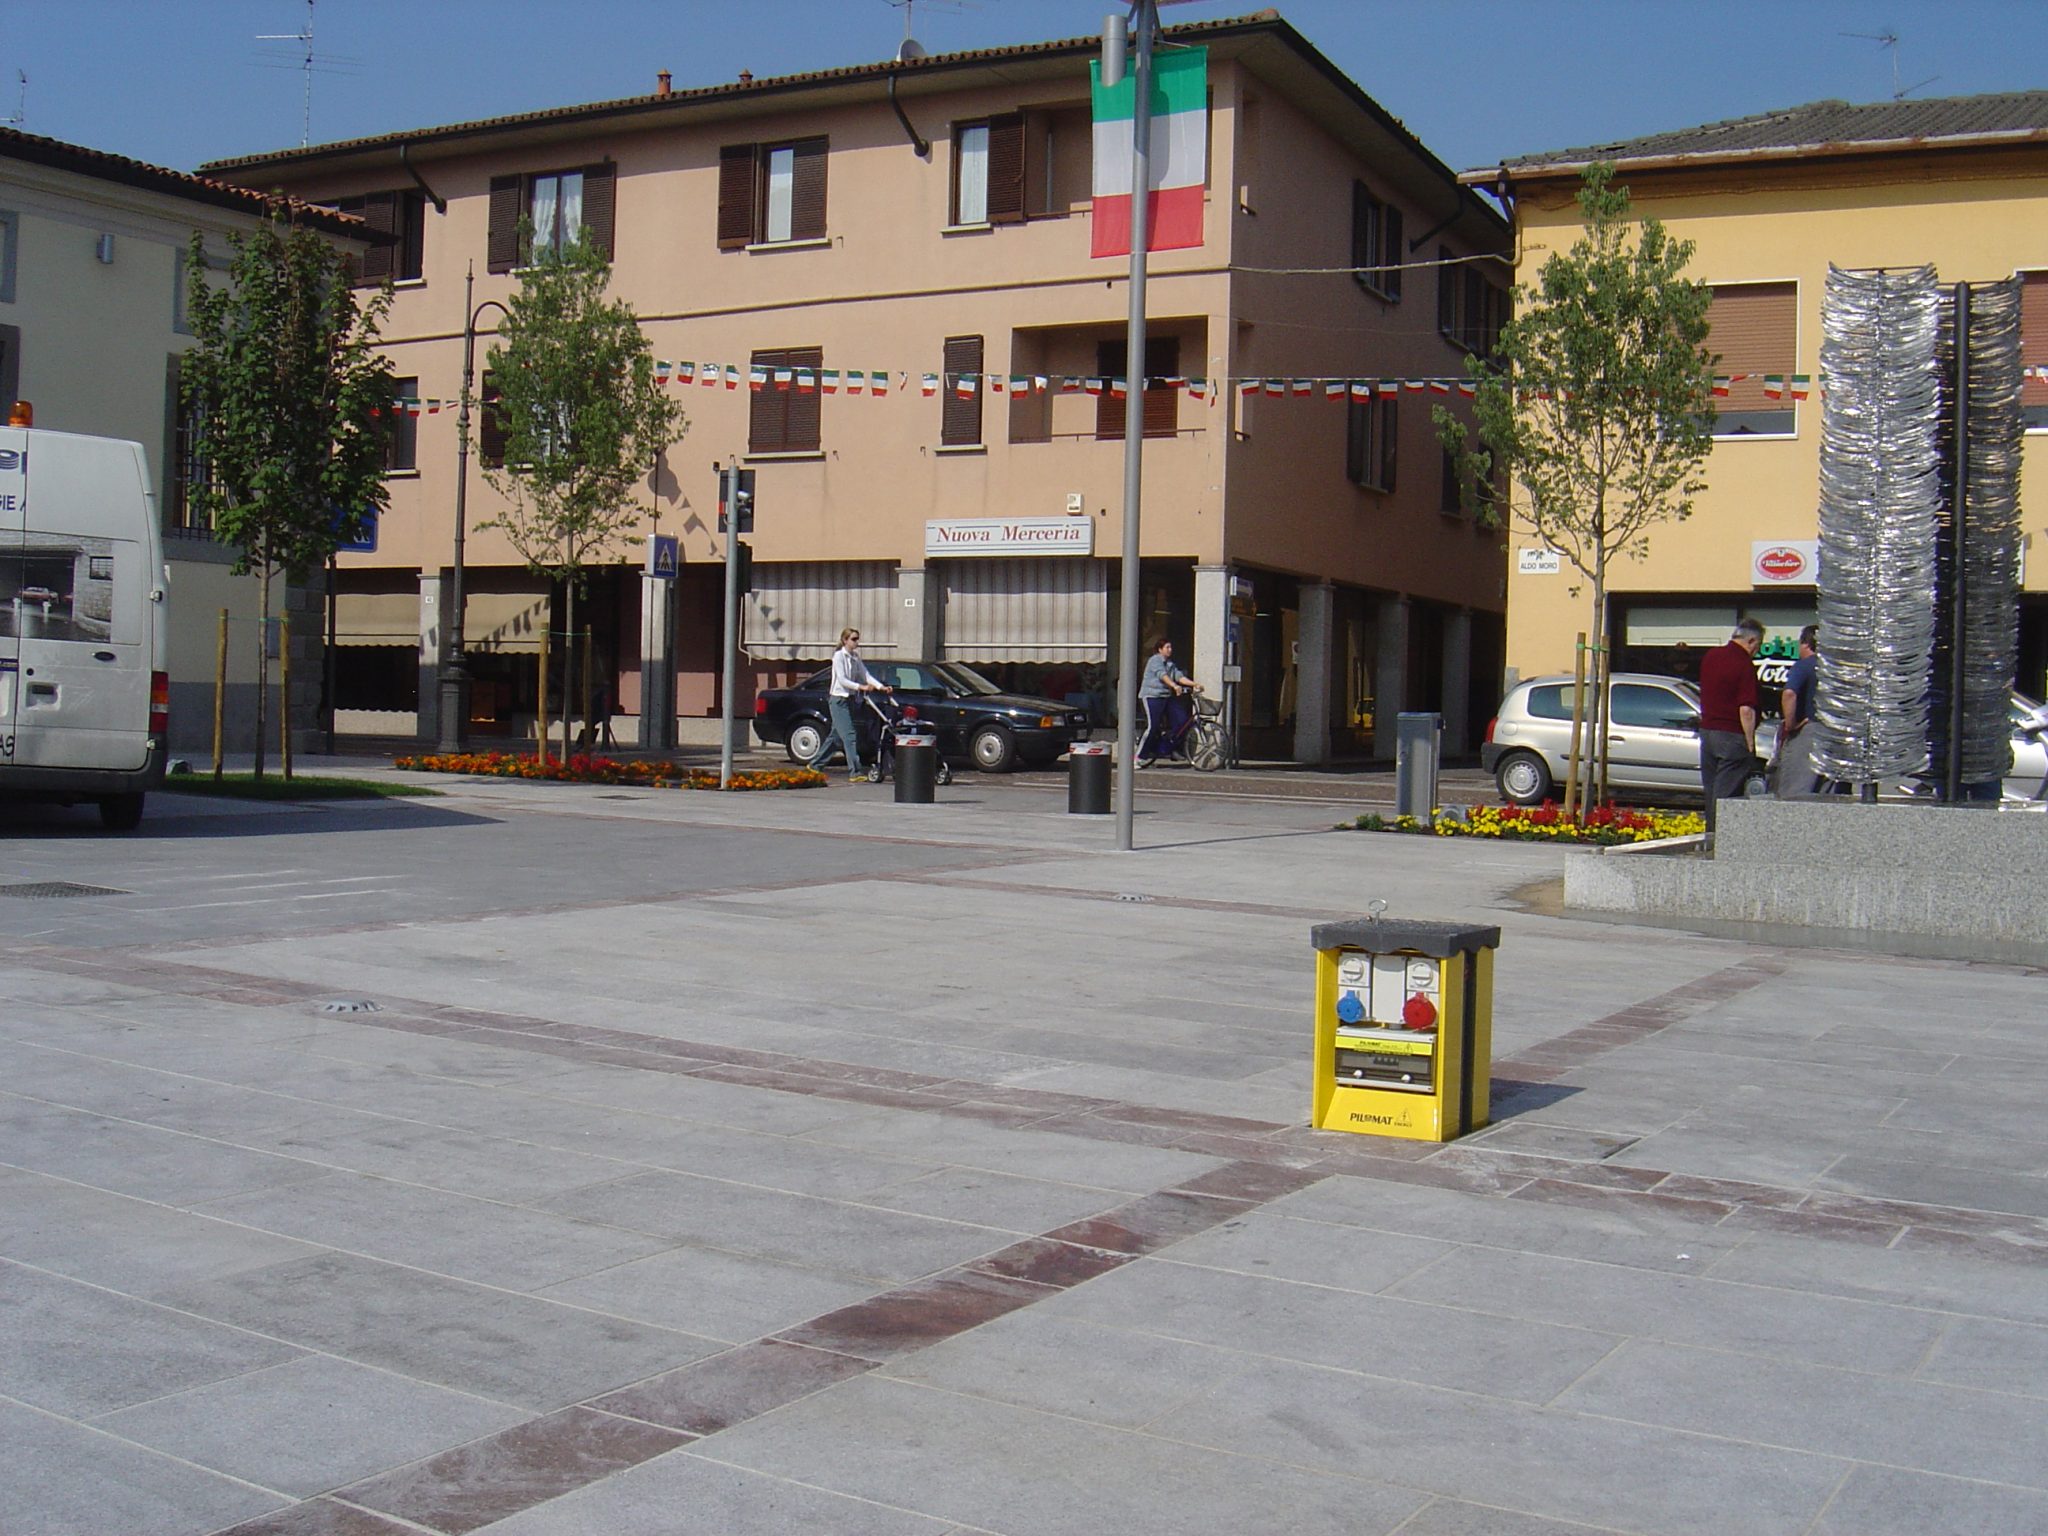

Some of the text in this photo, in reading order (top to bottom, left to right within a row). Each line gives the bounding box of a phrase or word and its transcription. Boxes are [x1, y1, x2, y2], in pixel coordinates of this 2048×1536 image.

[937, 524, 1080, 543] Nuova Merceria
[1520, 562, 1557, 570] ALDO MORO
[1350, 1112, 1392, 1125] PILOMAT
